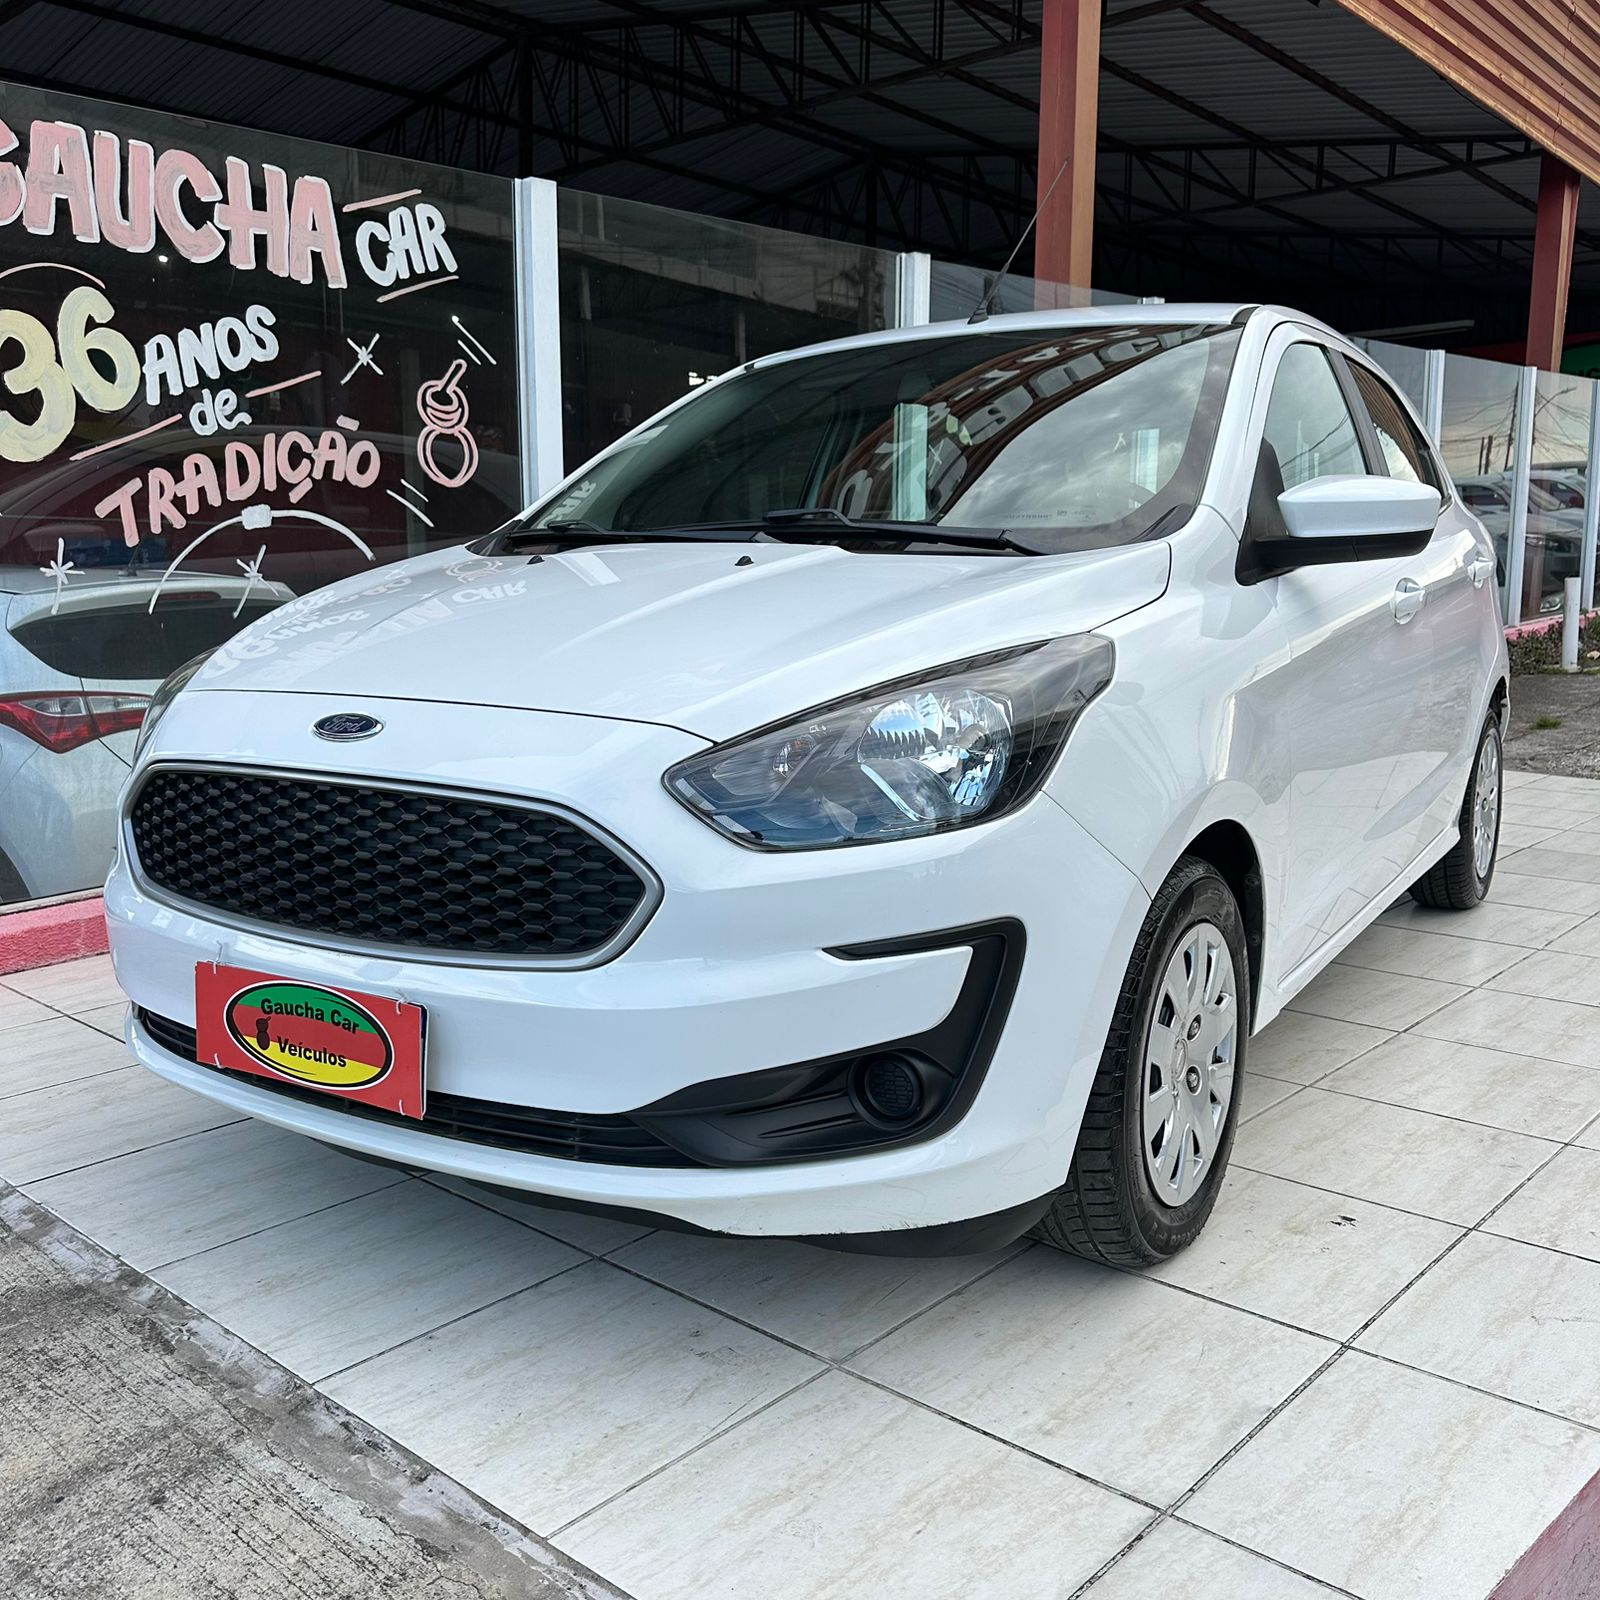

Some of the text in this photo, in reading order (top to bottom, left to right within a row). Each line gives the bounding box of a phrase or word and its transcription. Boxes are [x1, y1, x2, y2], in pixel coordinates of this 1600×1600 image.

[355, 203, 459, 287] CAR
[0, 286, 280, 463] 36 ANOS
[189, 388, 252, 436] de
[95, 415, 381, 547] TRADIÇÃO
[324, 715, 367, 733] Ford
[260, 998, 360, 1035] Gaucha Car
[277, 1036, 348, 1068] Veículos
